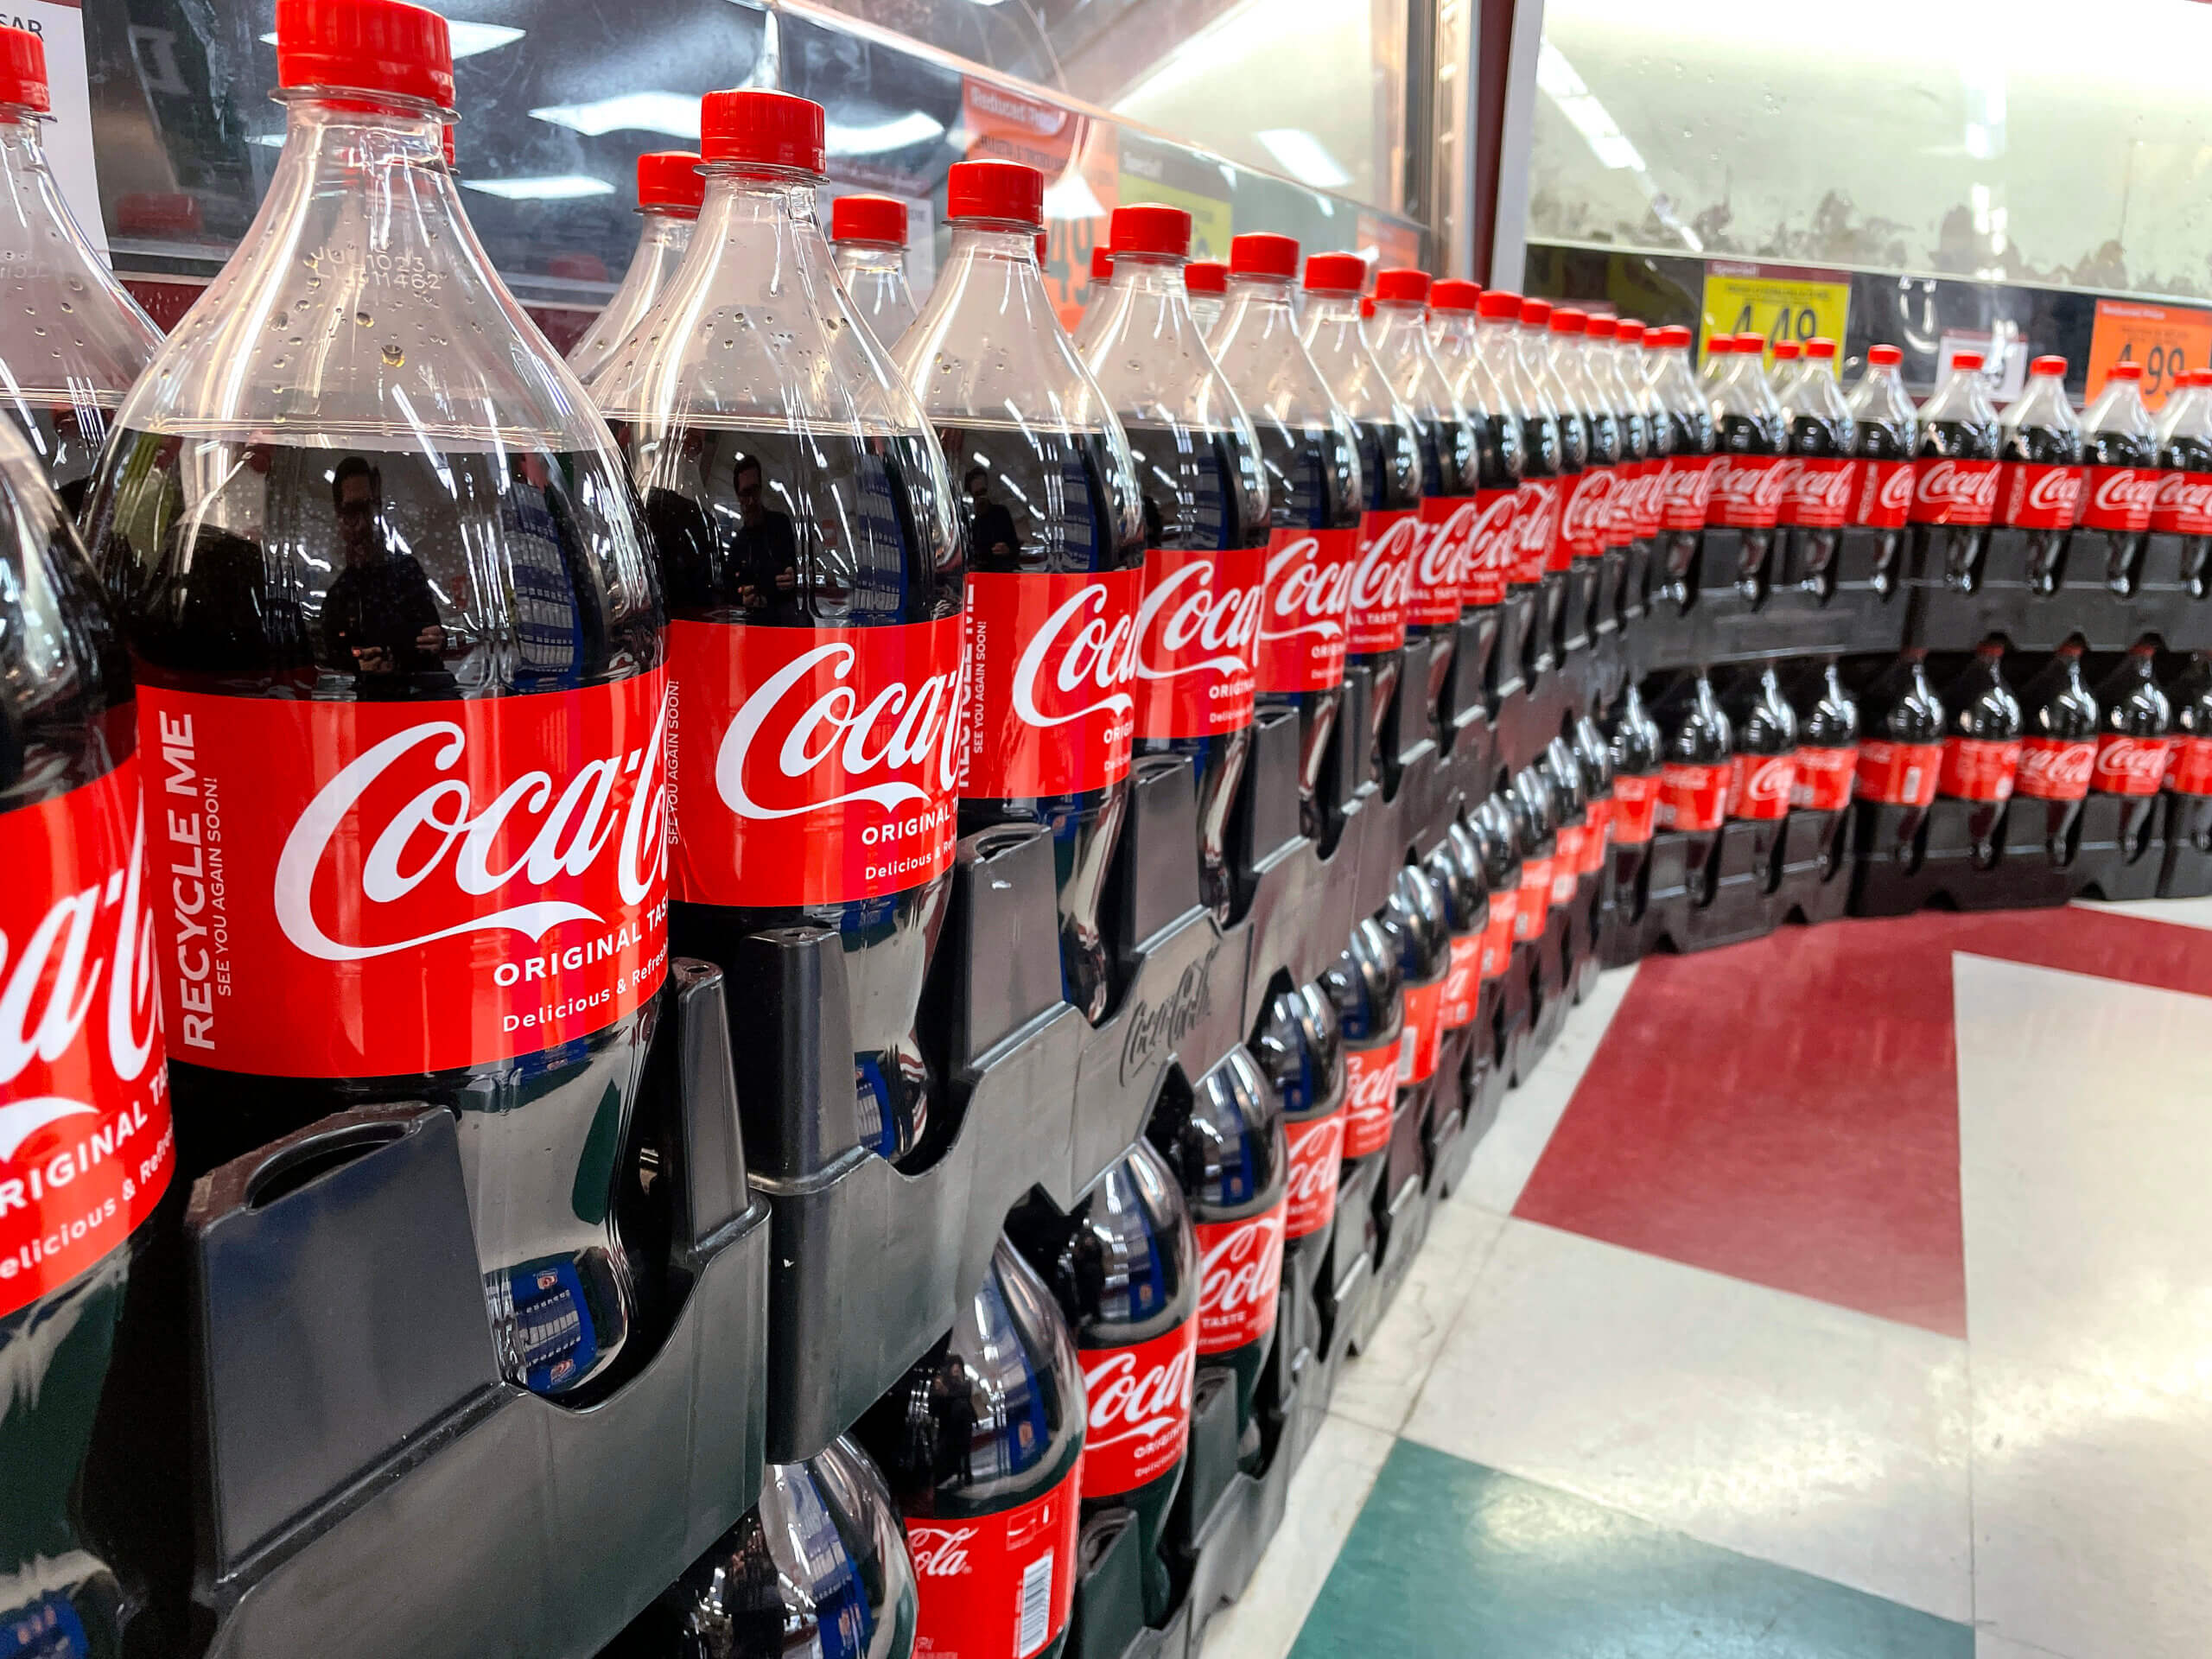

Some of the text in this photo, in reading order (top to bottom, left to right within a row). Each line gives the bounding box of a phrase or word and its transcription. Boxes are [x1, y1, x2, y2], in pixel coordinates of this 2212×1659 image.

[274, 677, 670, 962] Coca-C
[861, 803, 950, 846] ORIGINAL
[160, 710, 215, 1051] RECYCLE ME
[209, 849, 226, 909] AGAIN
[865, 852, 931, 880] Delicious
[213, 911, 229, 957] YOU
[493, 895, 669, 987] ORIGINAL TAS
[216, 959, 232, 997] SEE
[503, 938, 669, 1033] Delicious & Refres
[0, 1100, 149, 1218] RIGINAL
[0, 1197, 117, 1280] elicious
